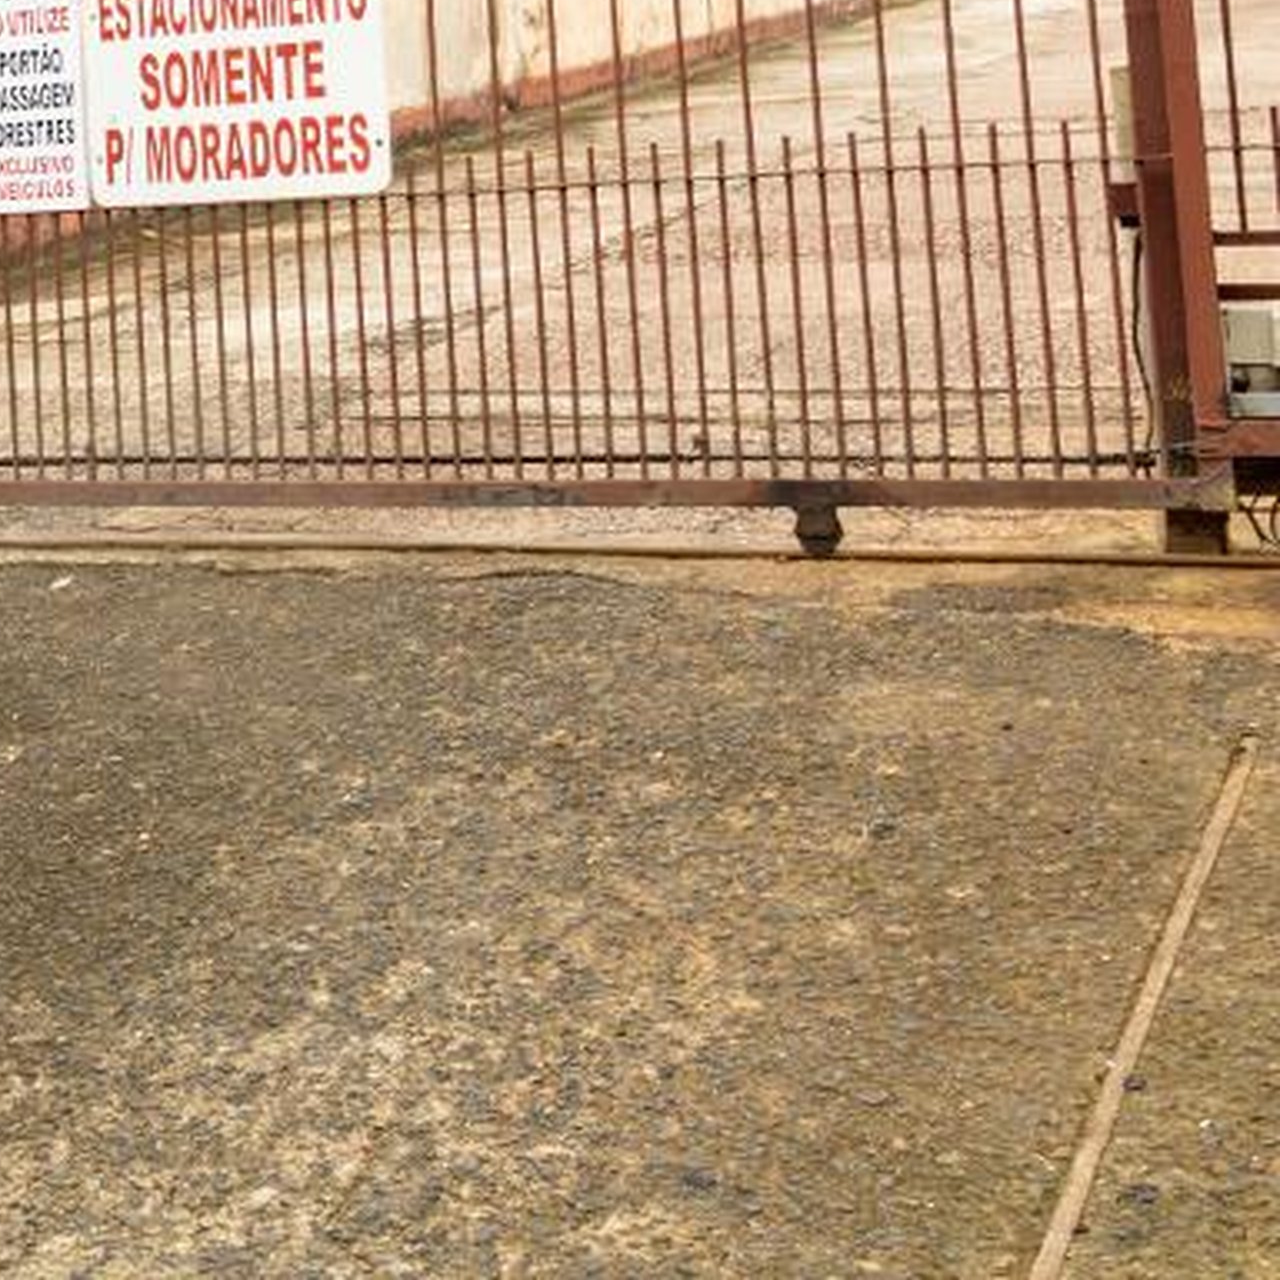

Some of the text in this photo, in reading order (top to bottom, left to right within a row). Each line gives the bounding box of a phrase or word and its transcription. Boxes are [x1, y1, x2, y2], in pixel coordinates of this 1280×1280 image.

[6, 6, 71, 37] UTILIZE
[139, 40, 326, 111] SOMENTE
[105, 114, 371, 186] P/ MORADORES
